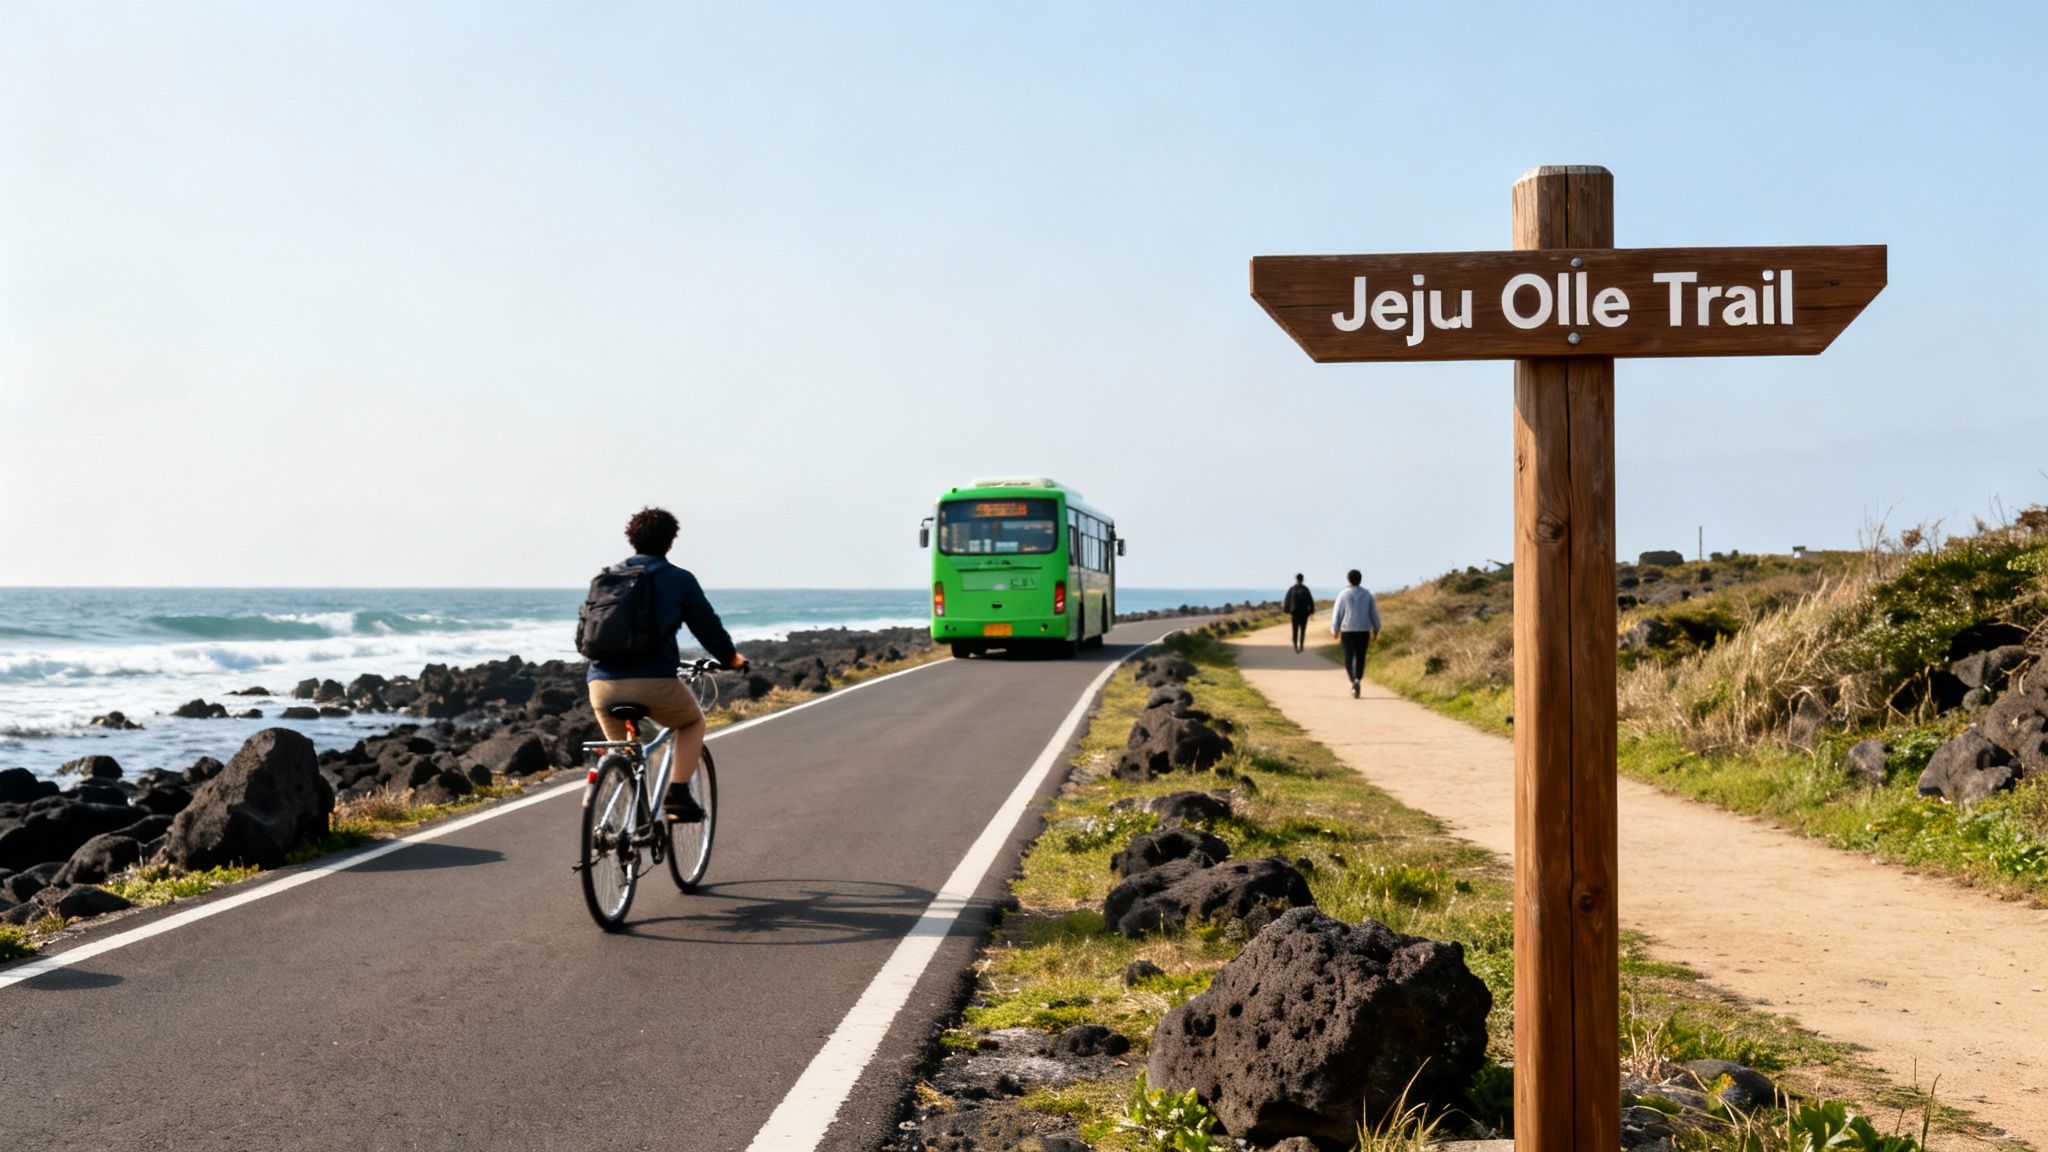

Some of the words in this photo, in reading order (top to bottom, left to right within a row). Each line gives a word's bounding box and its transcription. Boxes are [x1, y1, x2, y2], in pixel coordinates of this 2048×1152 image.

[1331, 274, 1473, 347] Jeju
[1501, 271, 1630, 330] Olle
[1653, 269, 1794, 328] Trail
